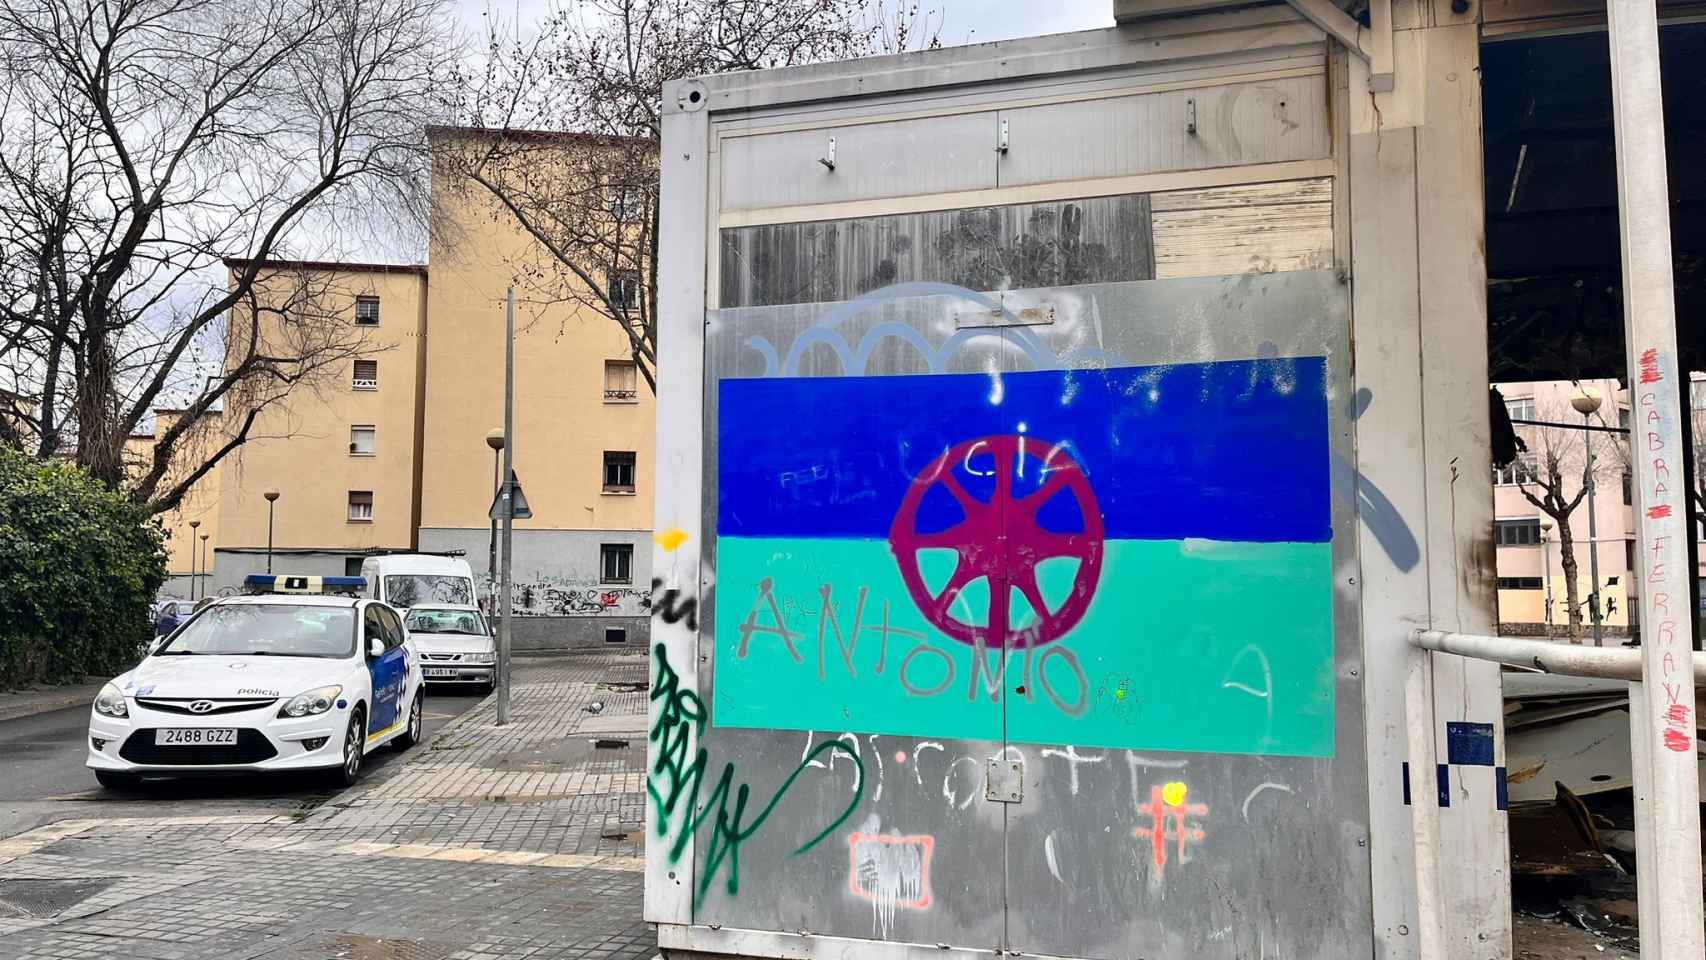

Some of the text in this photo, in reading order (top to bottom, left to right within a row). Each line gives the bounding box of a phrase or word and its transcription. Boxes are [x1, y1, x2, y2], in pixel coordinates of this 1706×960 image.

[1640, 392, 1681, 704] CABRA FERRAN
[166, 729, 233, 743] 2488 GZZ
